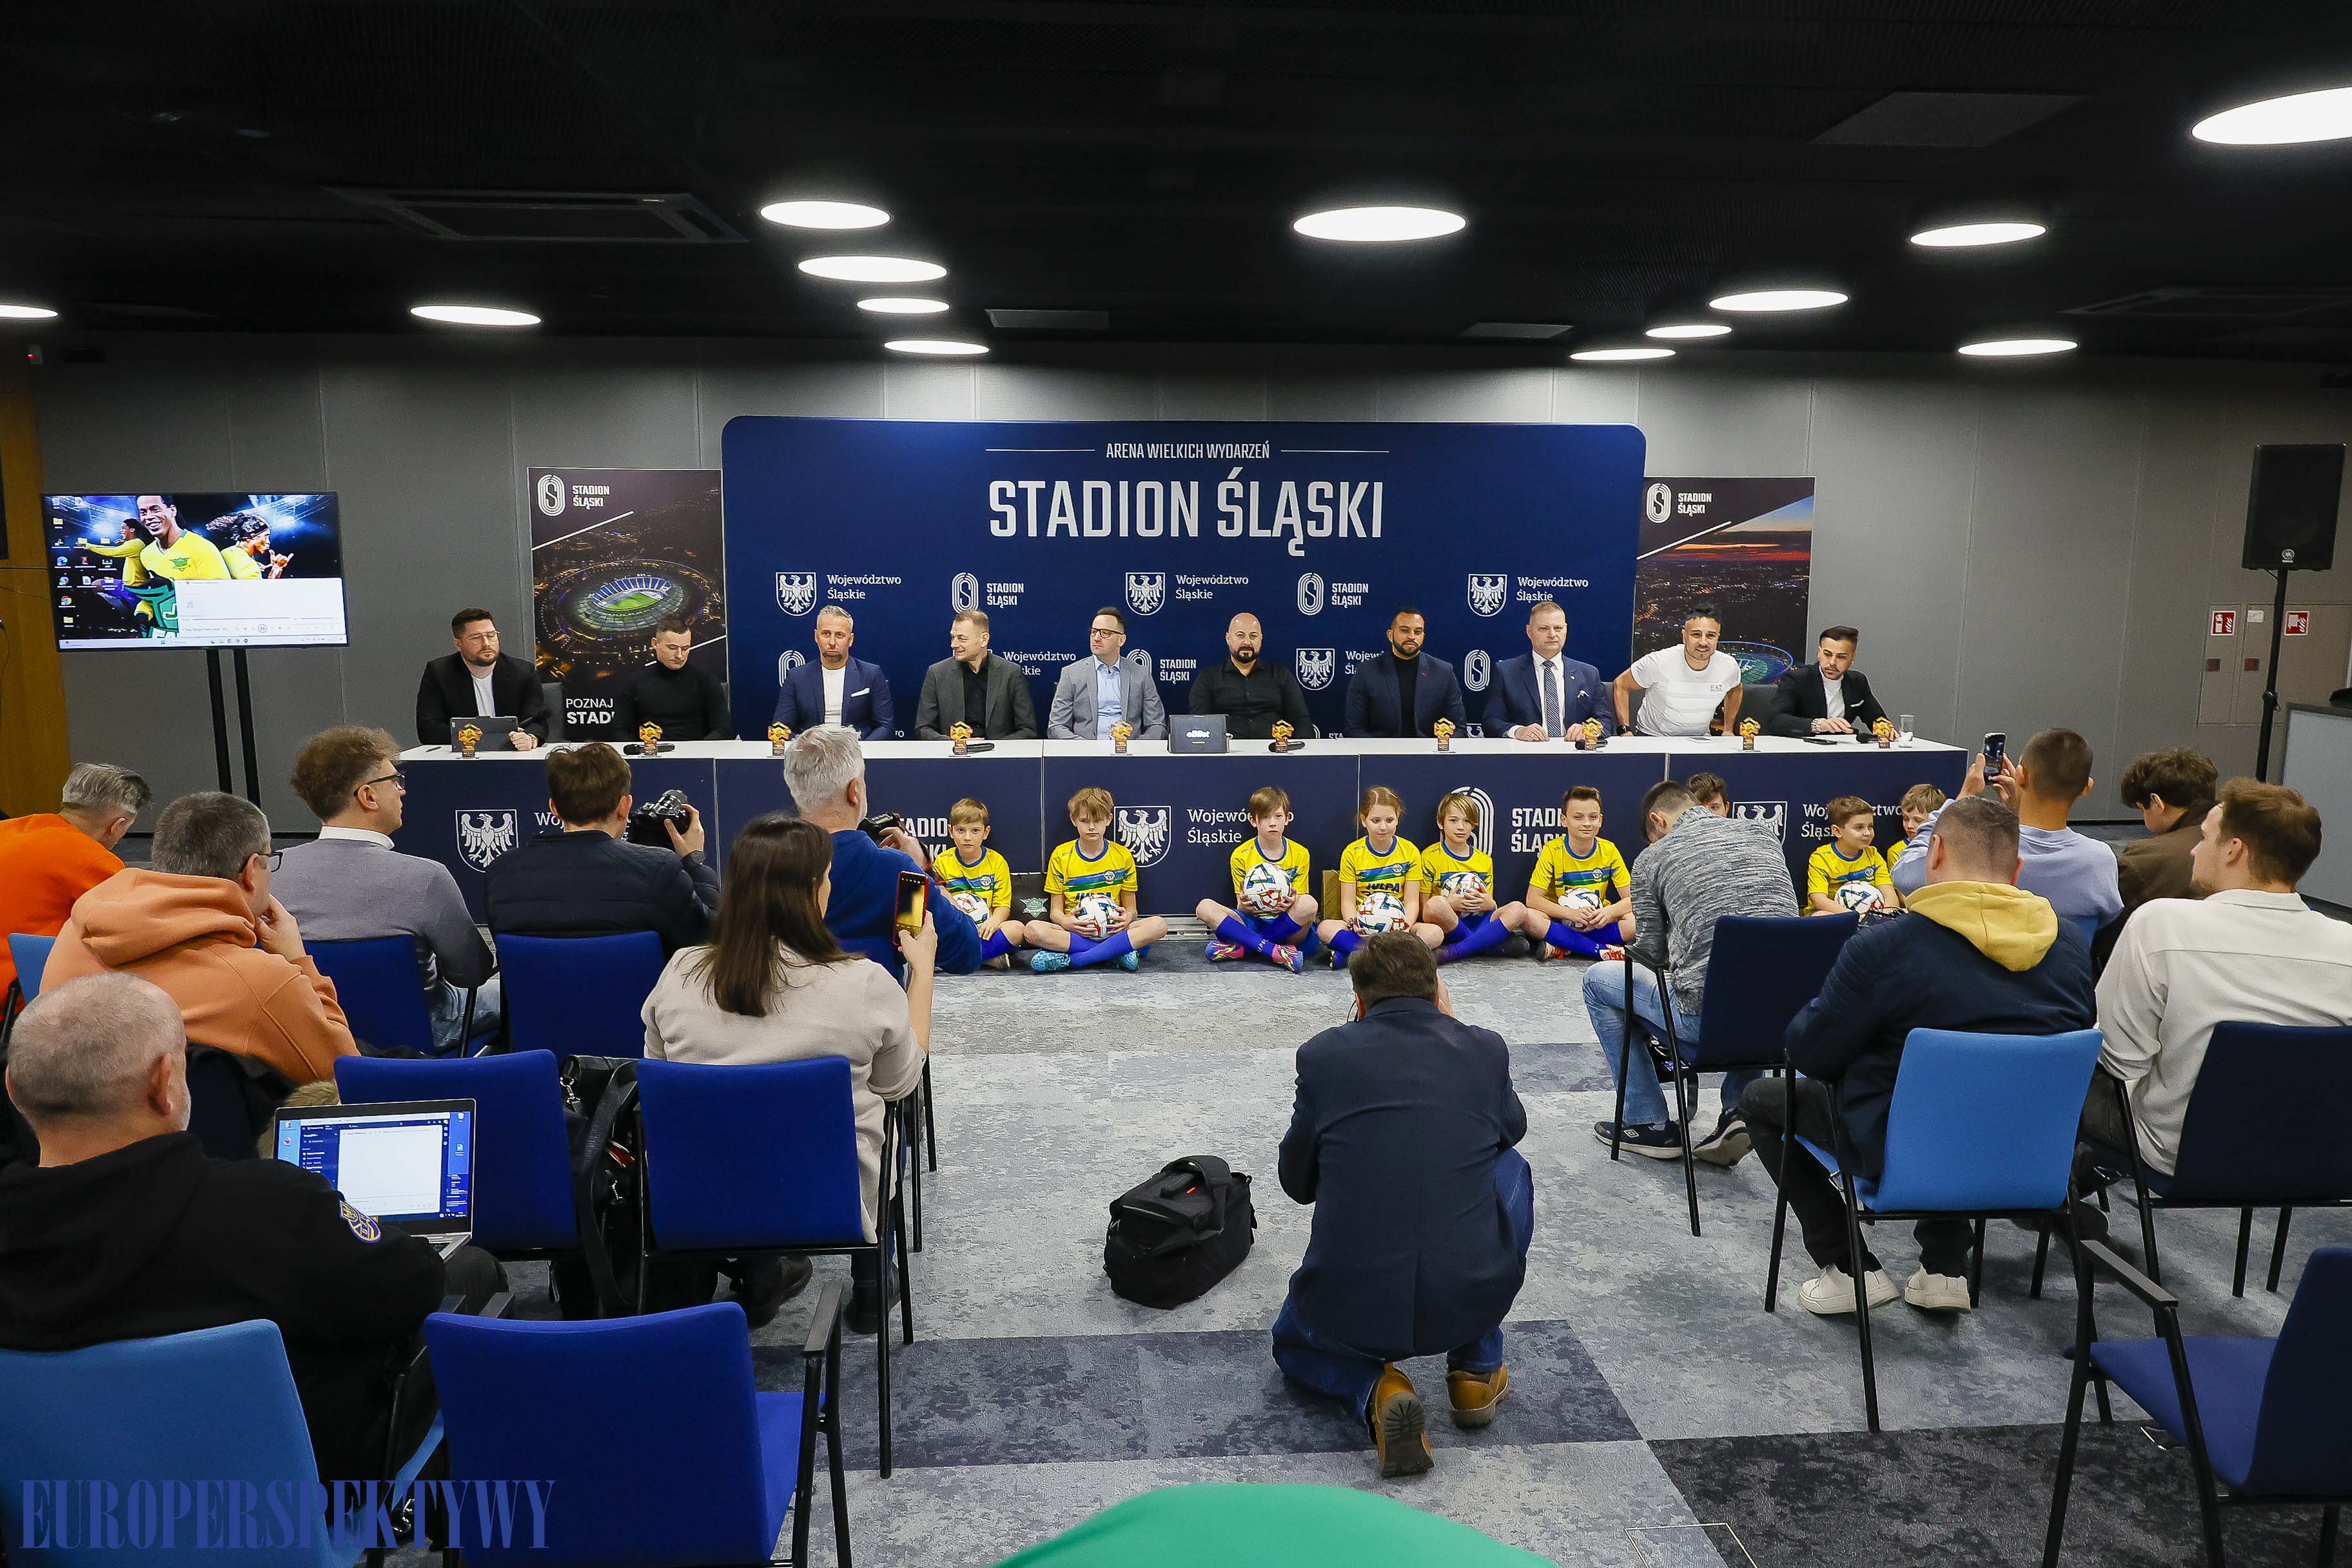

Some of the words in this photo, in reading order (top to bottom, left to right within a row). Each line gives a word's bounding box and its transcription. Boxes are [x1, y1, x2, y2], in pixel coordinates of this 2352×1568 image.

[1106, 443, 1144, 458] ARENA
[1146, 443, 1203, 458] WIELKICH
[1206, 440, 1269, 458] WYDARZEŃ
[572, 485, 610, 495] STADION
[573, 495, 604, 510] ŚLĄSKI
[1678, 493, 1712, 503] STADION
[989, 480, 1199, 537] STADION
[1217, 467, 1383, 557] ŚLĄSKI
[1678, 503, 1707, 517] ŚLĄSKI
[826, 574, 901, 587] Województwo
[1175, 574, 1250, 587] Województwo
[1516, 576, 1589, 589] Województwo
[827, 587, 866, 602] Śląskie
[986, 583, 1024, 593] STADION
[1175, 587, 1213, 602] Śląskie
[1331, 583, 1369, 593] STADION
[986, 593, 1018, 609] ŚLĄSKI
[1331, 593, 1362, 609] ŚLĄSKI
[1516, 589, 1553, 603] Śląskie
[1003, 651, 1077, 663] Województwo
[1160, 659, 1197, 669] STADION
[1160, 669, 1191, 684] ŚLĄSKI
[565, 698, 613, 709] POZNAJ
[1512, 807, 1562, 827] STADI
[1187, 827, 1242, 847] Śląskie
